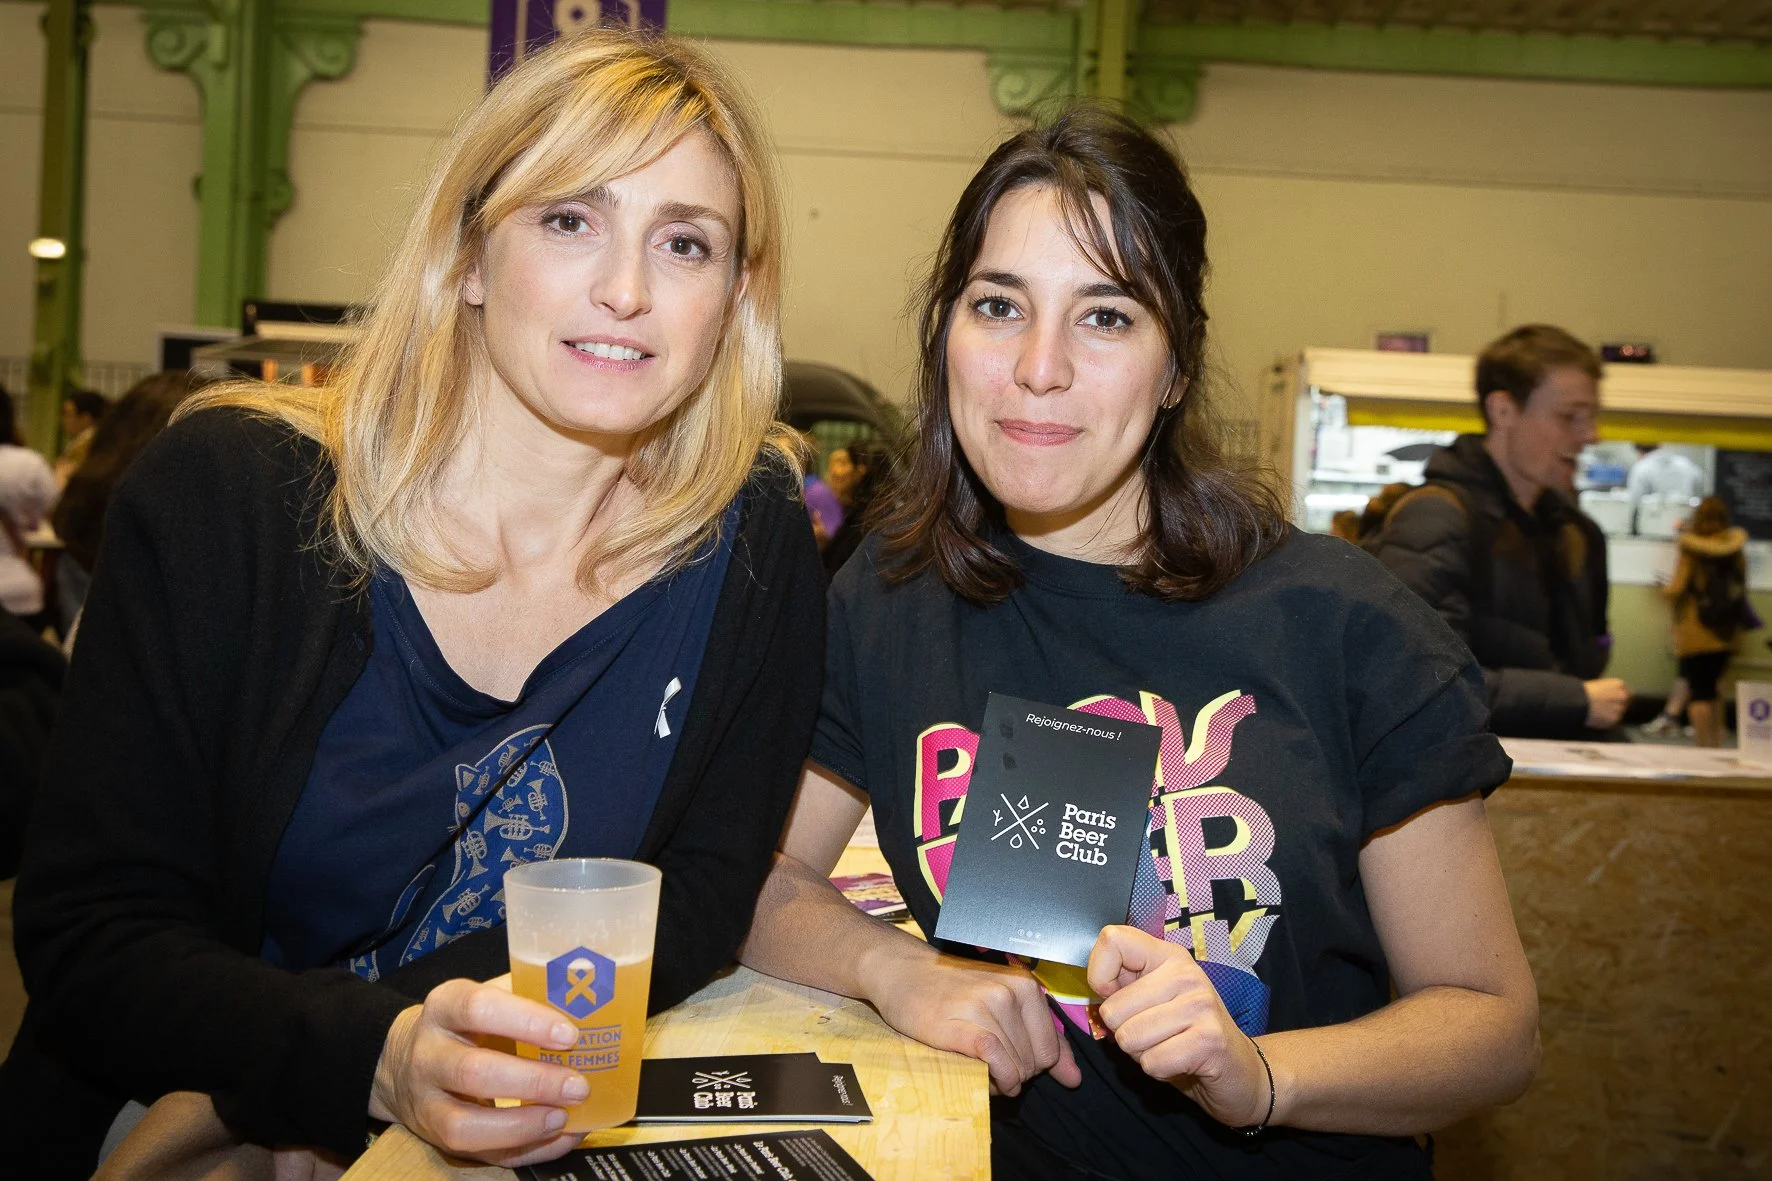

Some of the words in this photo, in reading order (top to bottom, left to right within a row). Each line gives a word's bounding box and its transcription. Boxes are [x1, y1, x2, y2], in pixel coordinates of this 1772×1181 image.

[1025, 713, 1116, 740] Rejoignez-nous
[1116, 731, 1122, 741] !
[1062, 802, 1117, 829] Paris
[1058, 821, 1109, 847] Beer
[1055, 840, 1108, 866] Club
[578, 1030, 622, 1045] ATION
[540, 1052, 562, 1066] DES
[567, 1051, 620, 1068] FEMMES
